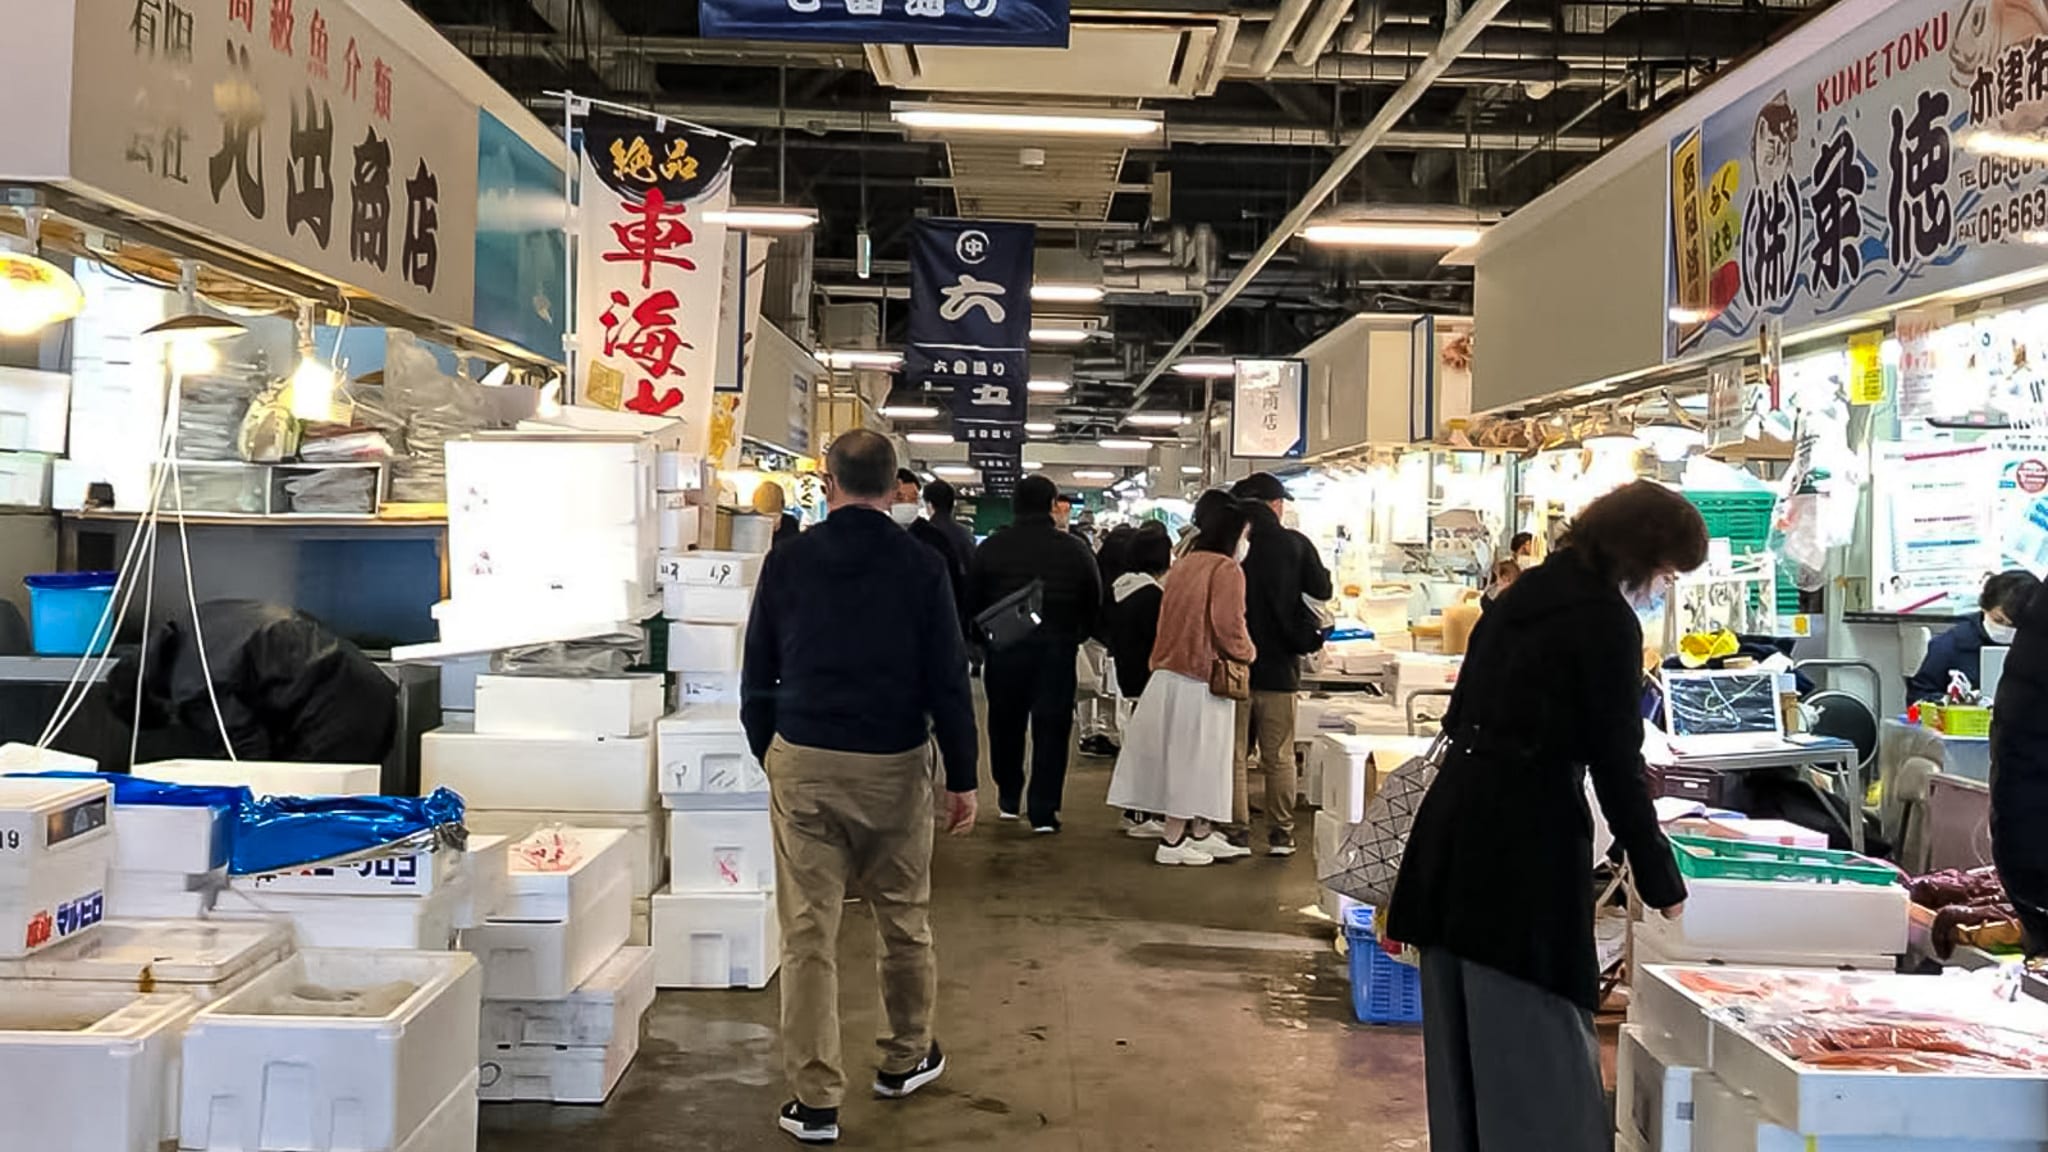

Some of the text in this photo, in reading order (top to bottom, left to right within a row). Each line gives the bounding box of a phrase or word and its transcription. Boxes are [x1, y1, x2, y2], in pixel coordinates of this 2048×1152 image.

[1816, 11, 1949, 114] KUMETOKU
[609, 135, 699, 182] 絶品
[1959, 169, 1977, 189] TEL
[940, 274, 1006, 323] 六
[933, 359, 1005, 377] 六番通り
